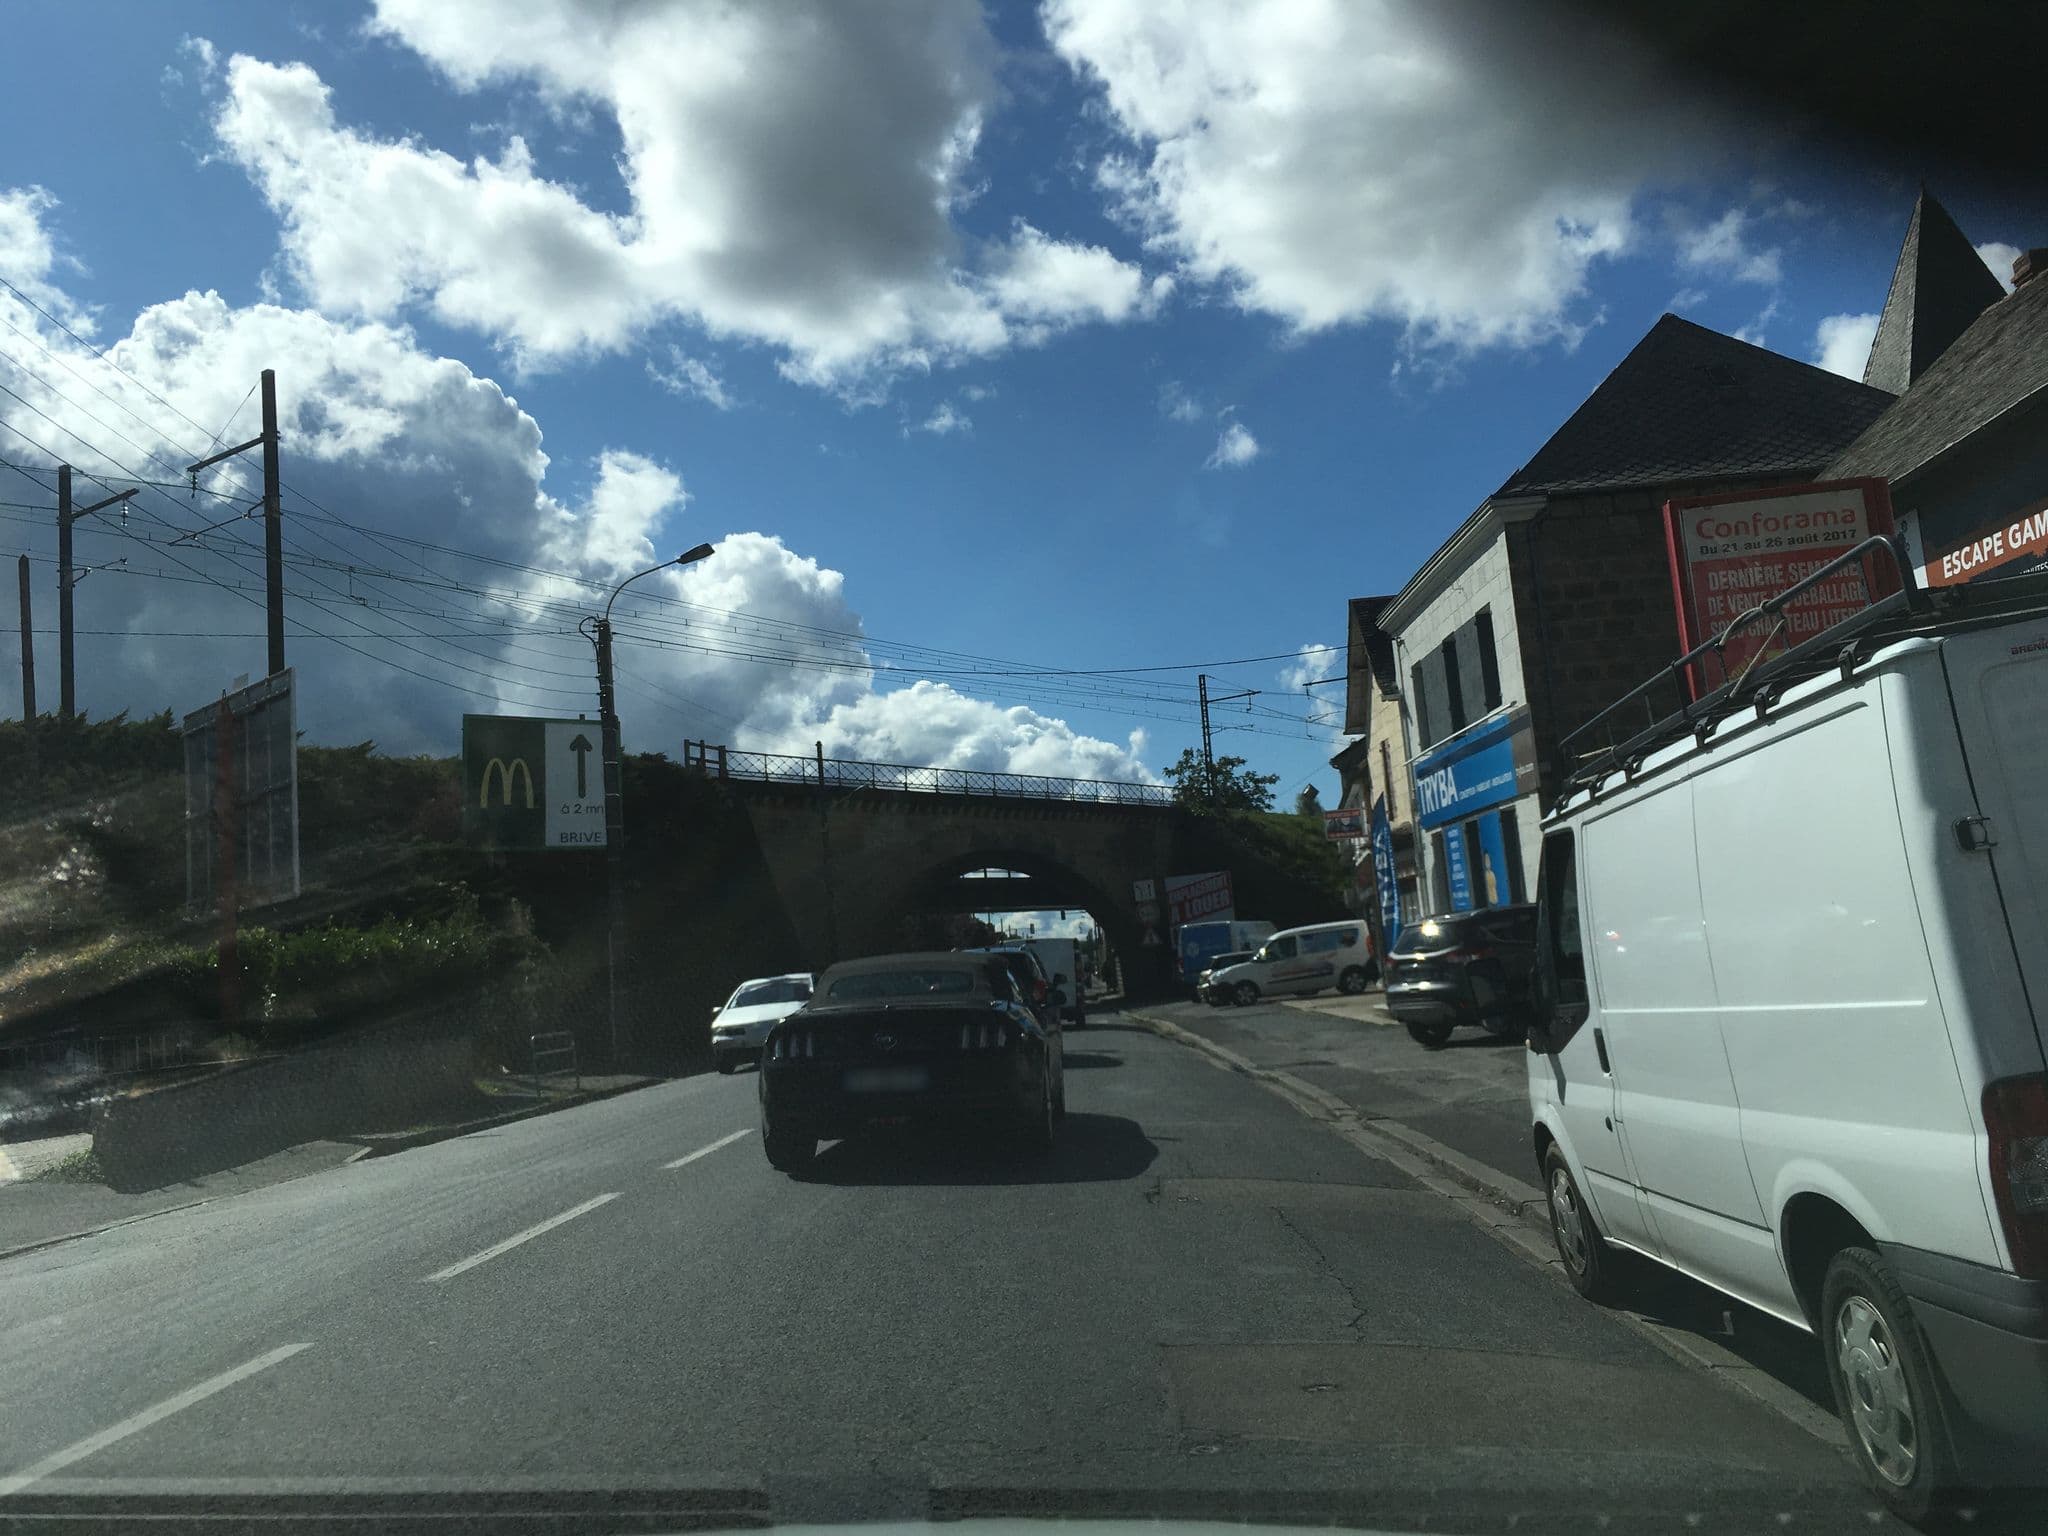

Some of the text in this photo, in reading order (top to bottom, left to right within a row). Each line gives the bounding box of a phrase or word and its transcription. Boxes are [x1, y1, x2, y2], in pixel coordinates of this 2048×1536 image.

[1696, 508, 1857, 540] Conforama
[1699, 545, 1718, 556] Du
[1722, 542, 1738, 554] 21
[1744, 540, 1761, 551] au
[1787, 533, 1819, 546] août
[1823, 529, 1857, 542] 2017
[1942, 508, 2048, 579] ESCAPE GAM
[1708, 561, 1784, 592] DERNIÈRE
[1707, 595, 1724, 617] DE
[1748, 610, 1819, 639] CHATEAU
[1416, 766, 1459, 816] TRYBA
[574, 803, 582, 814] 2
[560, 831, 602, 843] BRIVE
[1184, 888, 1230, 918] LOUER
